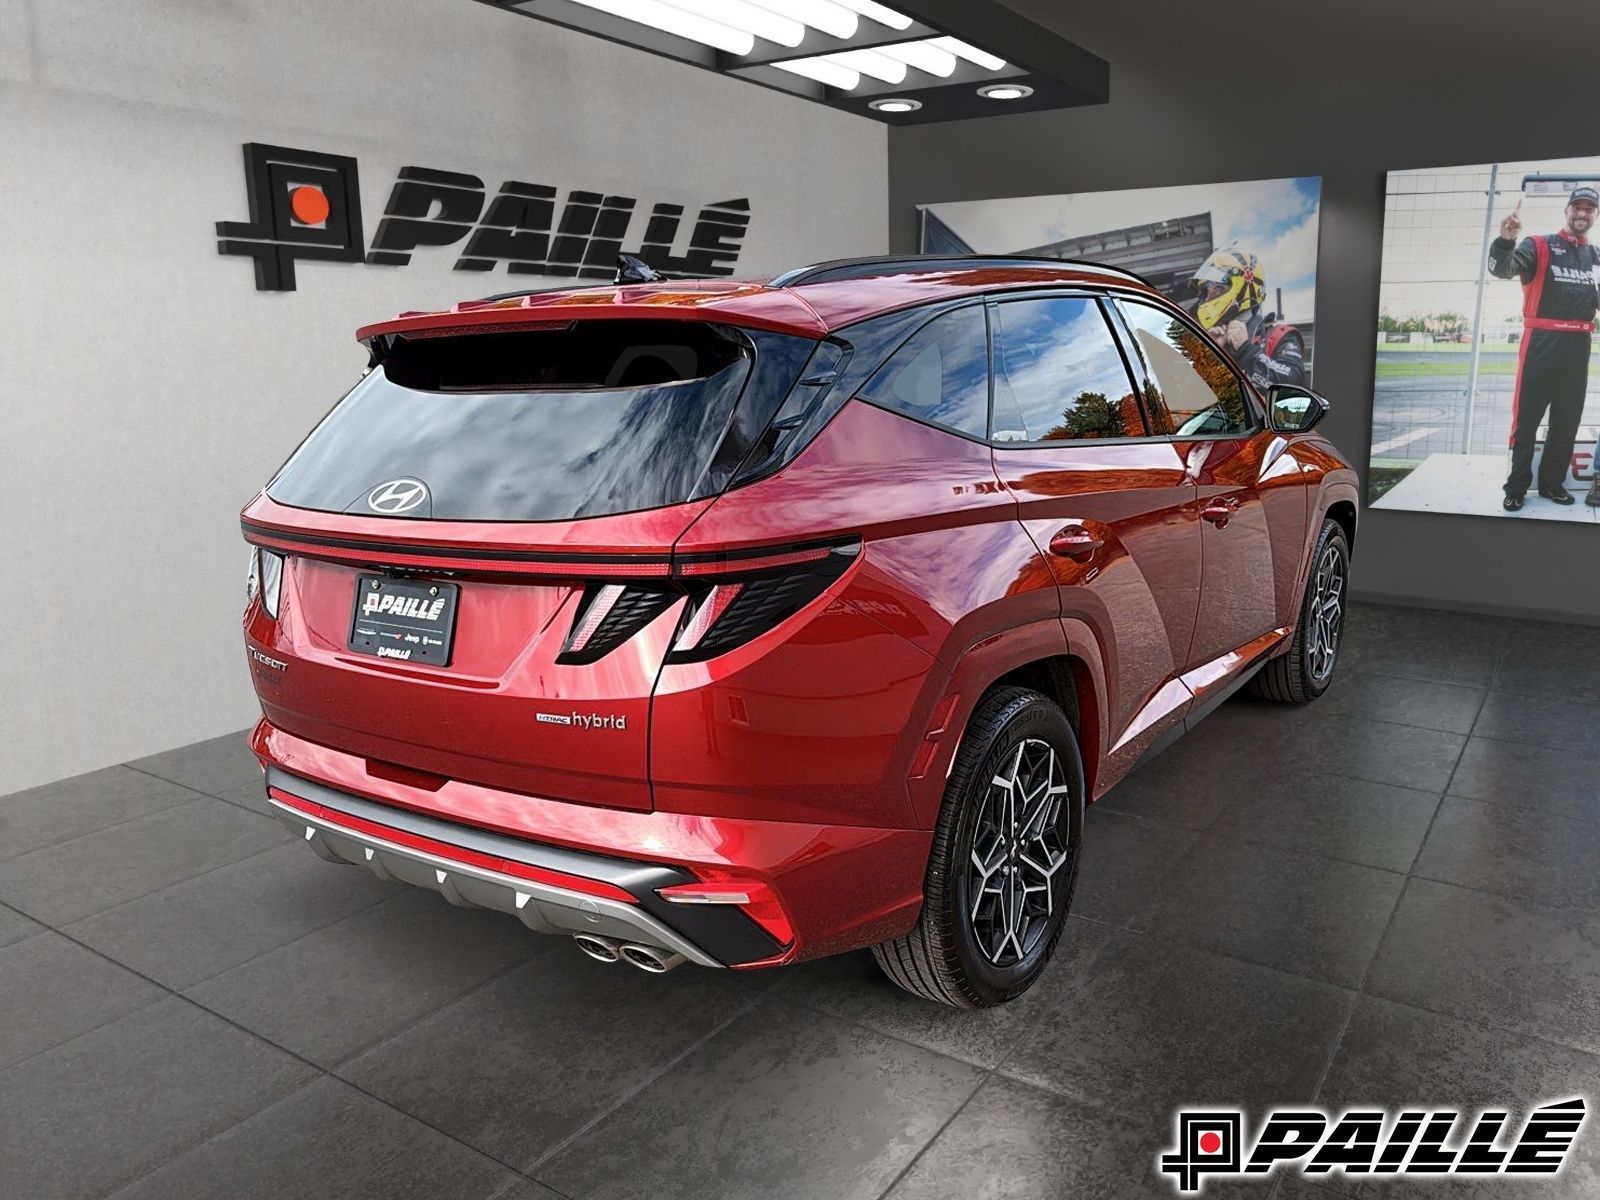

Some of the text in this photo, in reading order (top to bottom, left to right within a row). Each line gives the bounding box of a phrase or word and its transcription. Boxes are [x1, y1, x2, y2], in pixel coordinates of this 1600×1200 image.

[365, 166, 750, 278] PAILLÉ
[378, 594, 445, 621] PAILLÉ
[572, 711, 626, 730] hybrid
